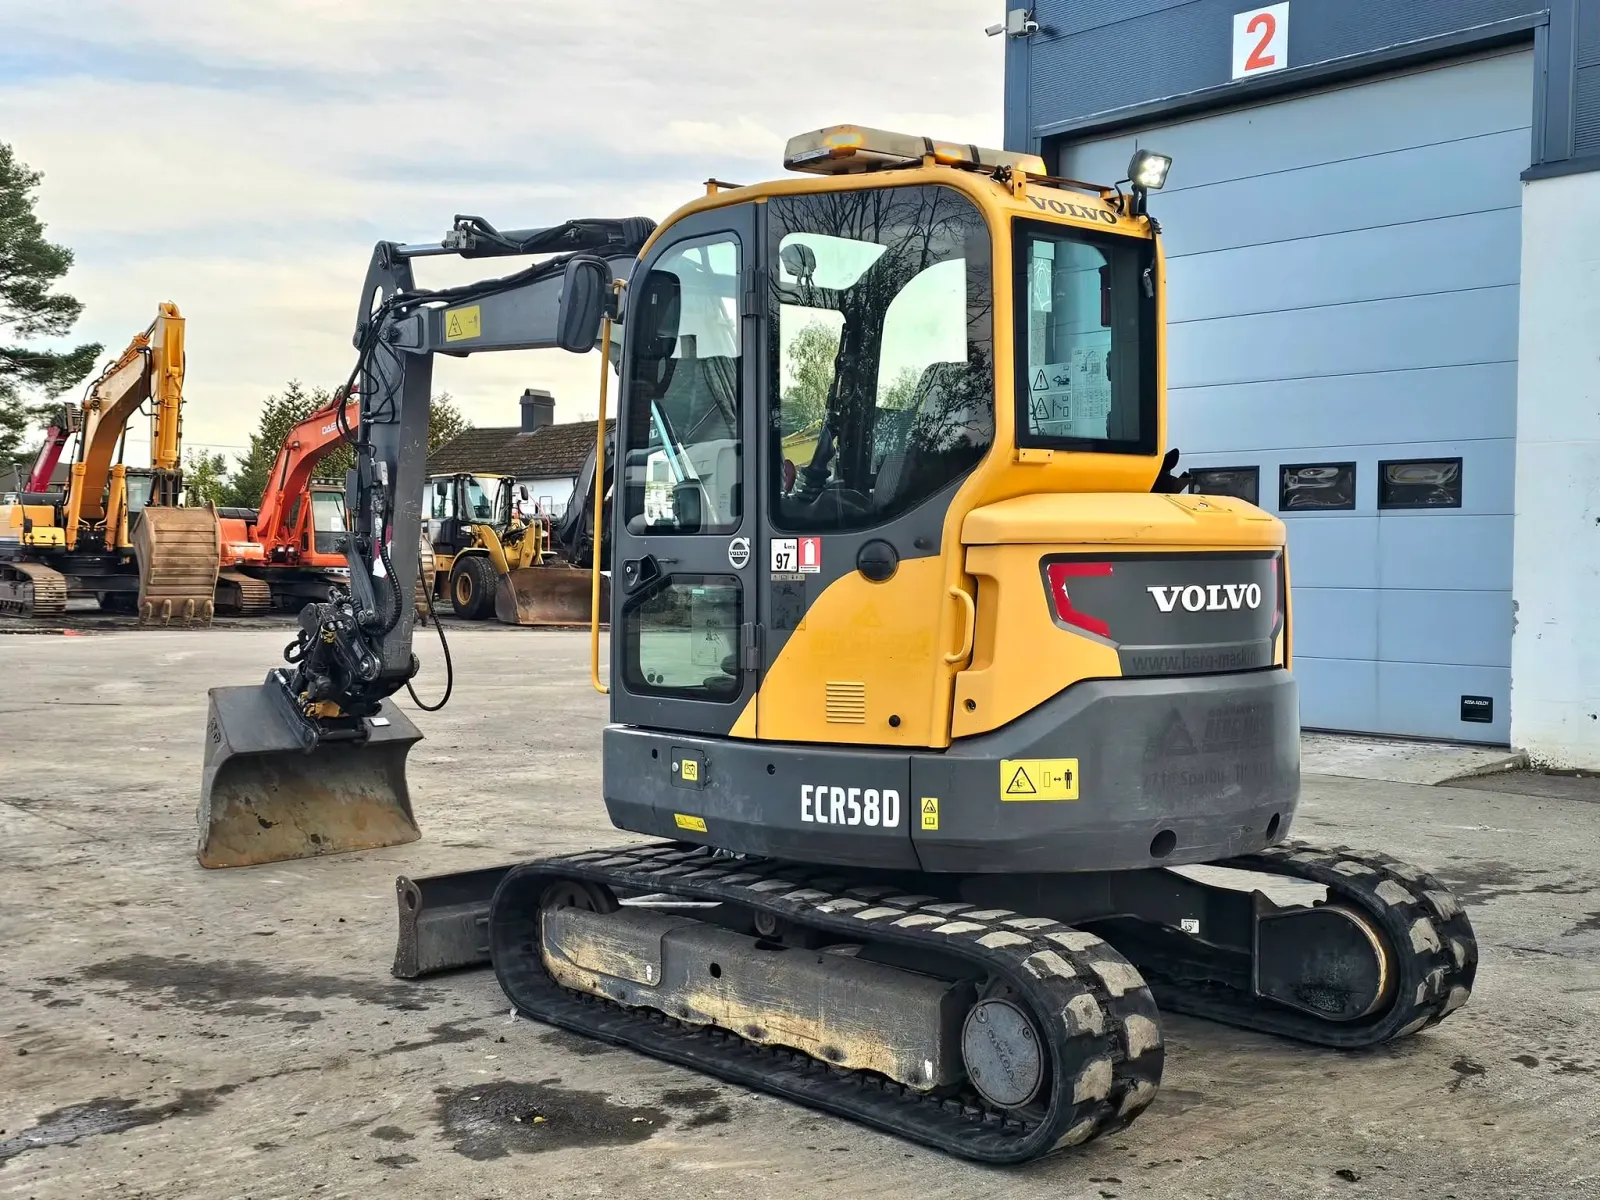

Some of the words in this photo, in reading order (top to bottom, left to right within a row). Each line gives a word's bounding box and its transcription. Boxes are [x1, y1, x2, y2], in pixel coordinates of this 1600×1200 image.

[1244, 12, 1276, 71] 2
[1026, 194, 1118, 225] VOLVO
[321, 416, 351, 435] DAEO
[776, 553, 790, 570] 97
[1146, 583, 1262, 613] VOLVO
[801, 784, 900, 828] ECR58D
